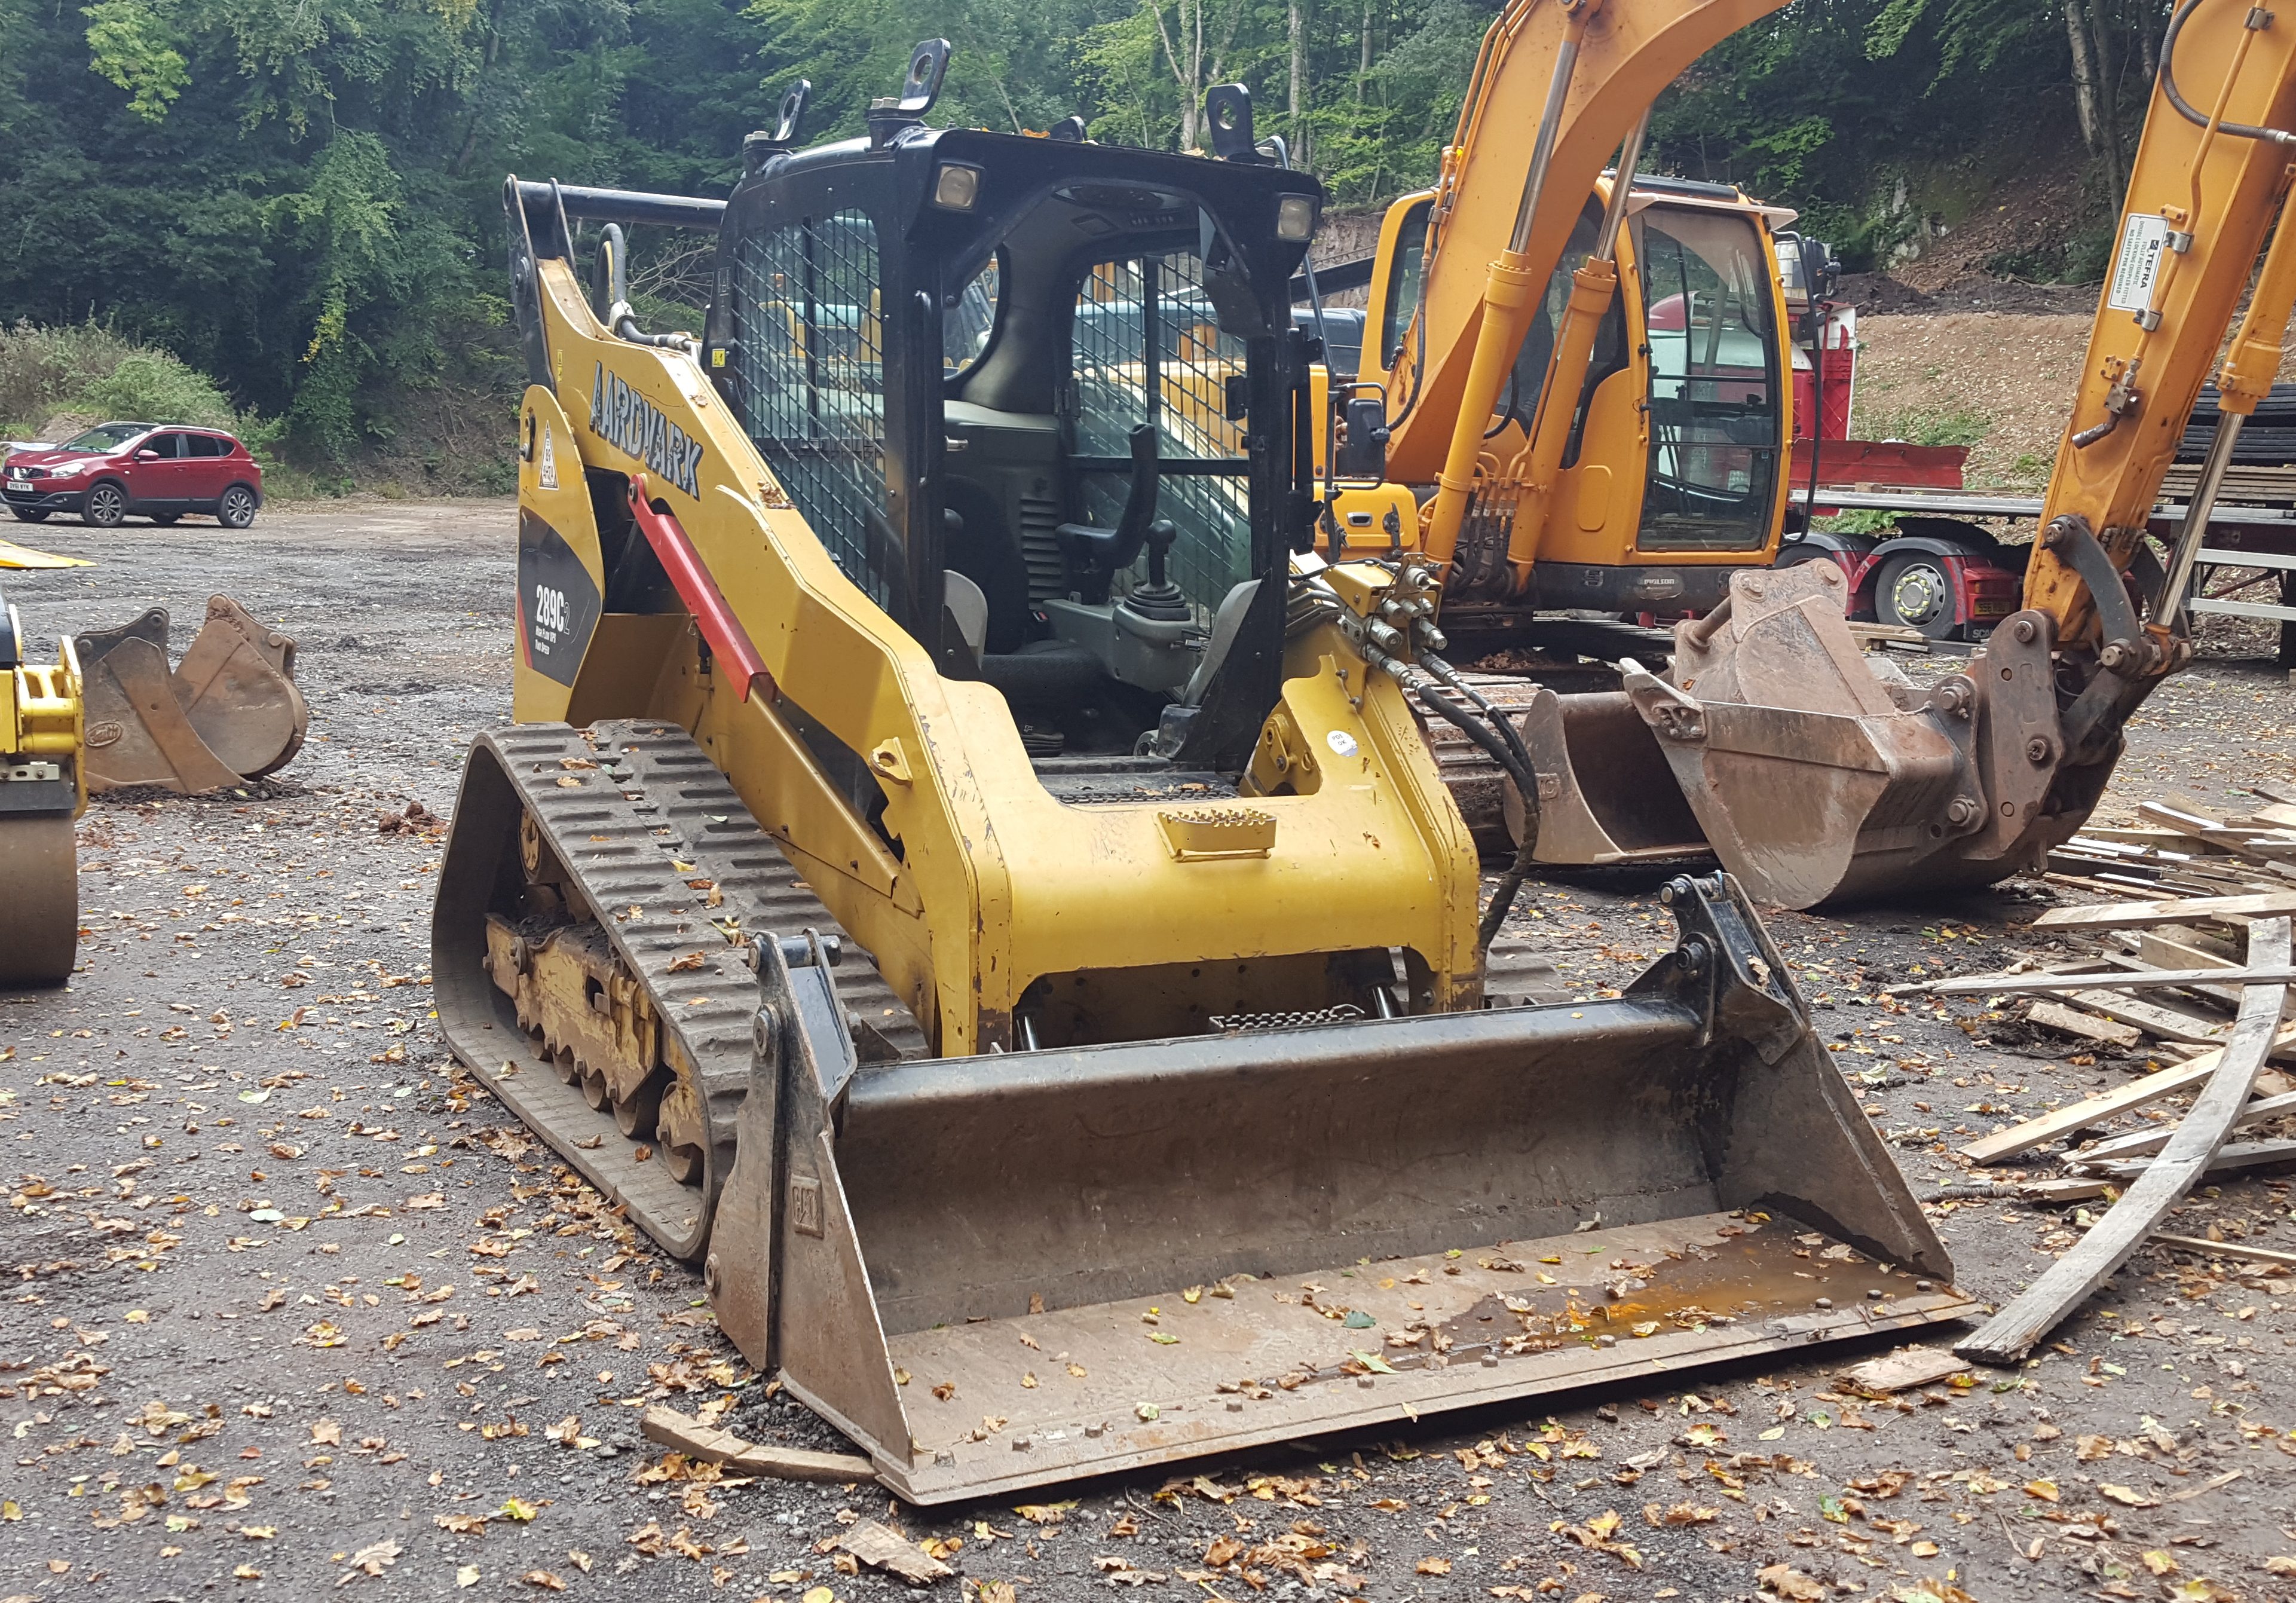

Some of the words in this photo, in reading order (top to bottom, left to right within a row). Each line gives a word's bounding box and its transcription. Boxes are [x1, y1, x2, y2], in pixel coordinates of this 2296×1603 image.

[2136, 221, 2145, 240] DOUBLE
[2132, 242, 2140, 263] LOCKING
[2116, 268, 2126, 294] REQUIRED
[2126, 264, 2135, 286] COUPLER
[2133, 257, 2144, 285] AUTOMATIC
[2140, 252, 2154, 289] TEFRA
[589, 359, 704, 502] AARDVARK
[1972, 629, 1994, 638] SCA
